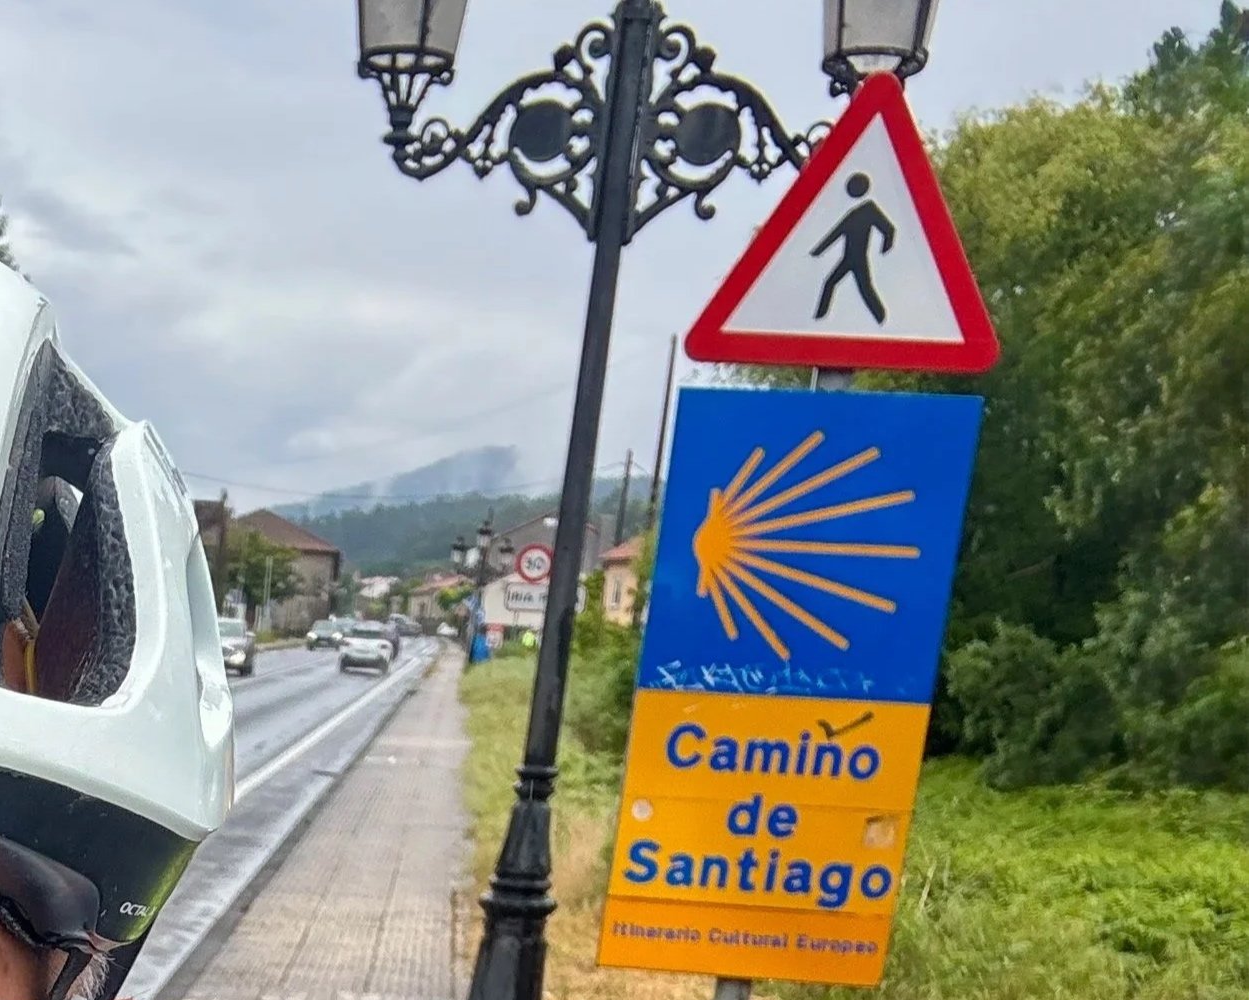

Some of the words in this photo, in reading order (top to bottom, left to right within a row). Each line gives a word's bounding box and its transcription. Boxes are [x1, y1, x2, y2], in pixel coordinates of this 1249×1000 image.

[726, 795, 799, 838] de
[623, 839, 892, 909] Santiago
[612, 920, 701, 943] Itinerario
[708, 926, 789, 949] Cultural
[796, 933, 879, 955] Europeo
